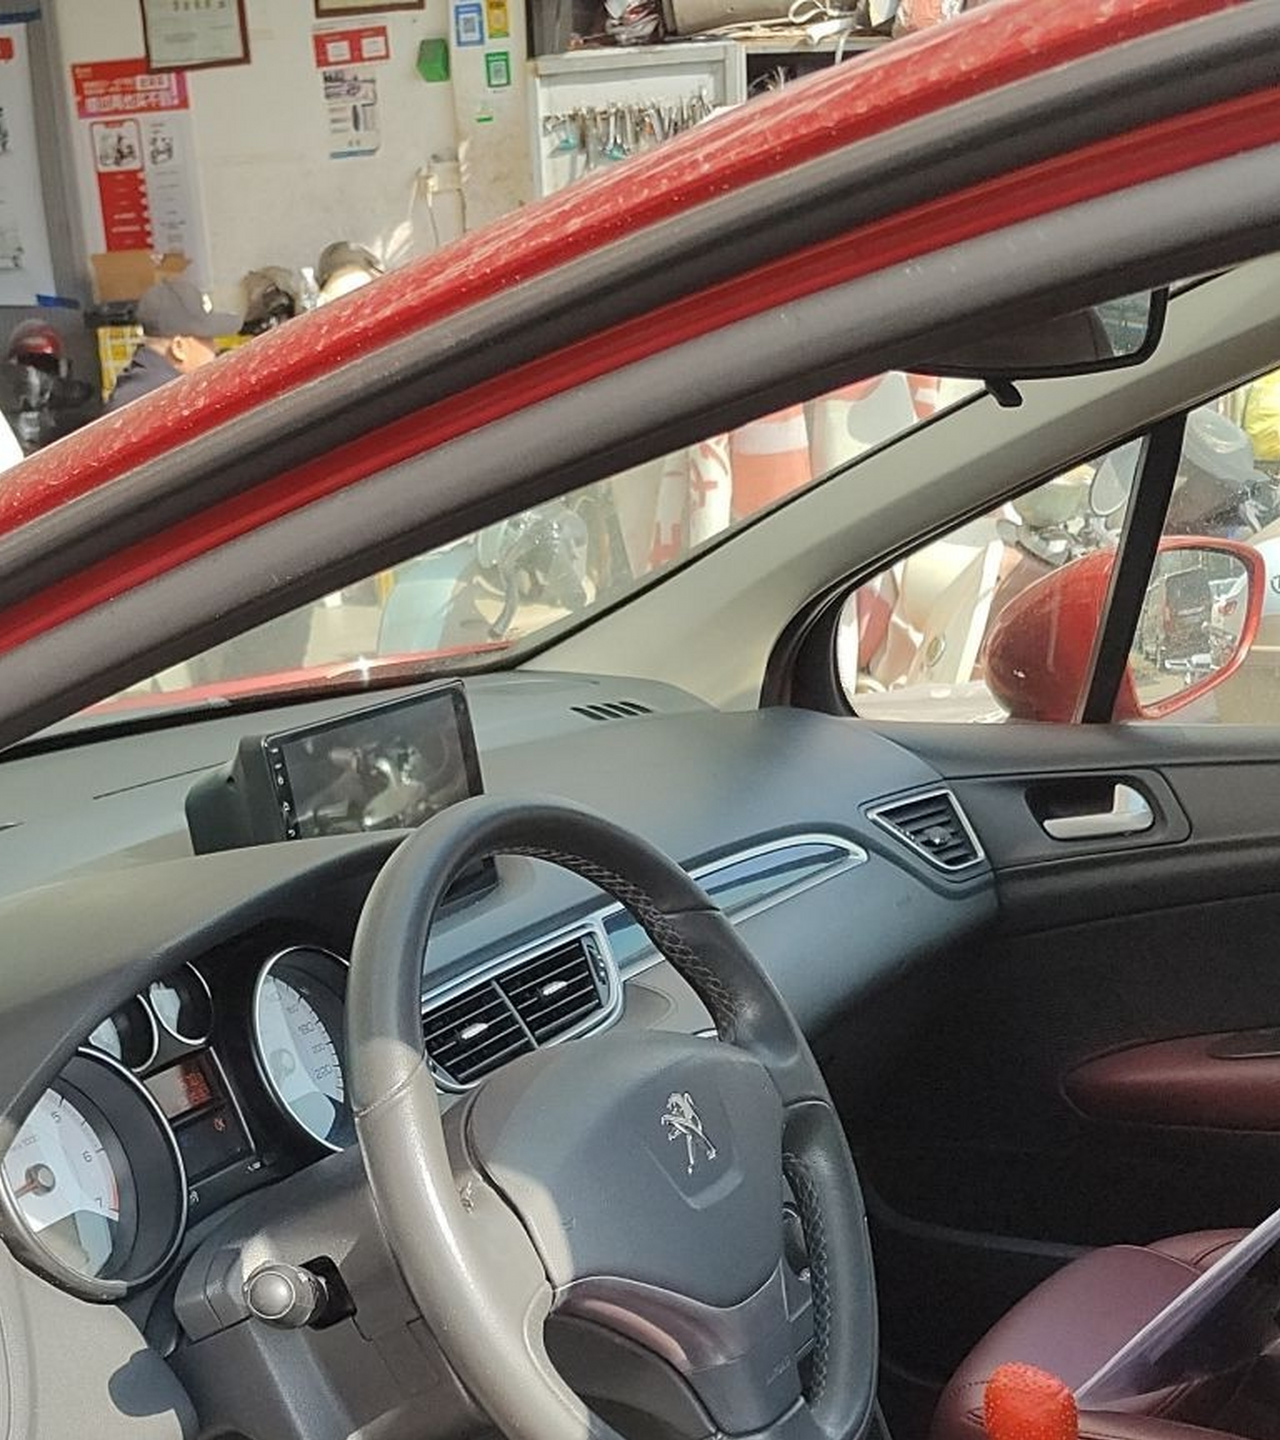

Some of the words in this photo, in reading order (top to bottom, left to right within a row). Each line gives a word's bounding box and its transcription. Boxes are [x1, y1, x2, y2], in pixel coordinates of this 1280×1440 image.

[50, 1110, 62, 1124] 5
[82, 1150, 93, 1163] 6
[95, 1197, 104, 1209] 7
